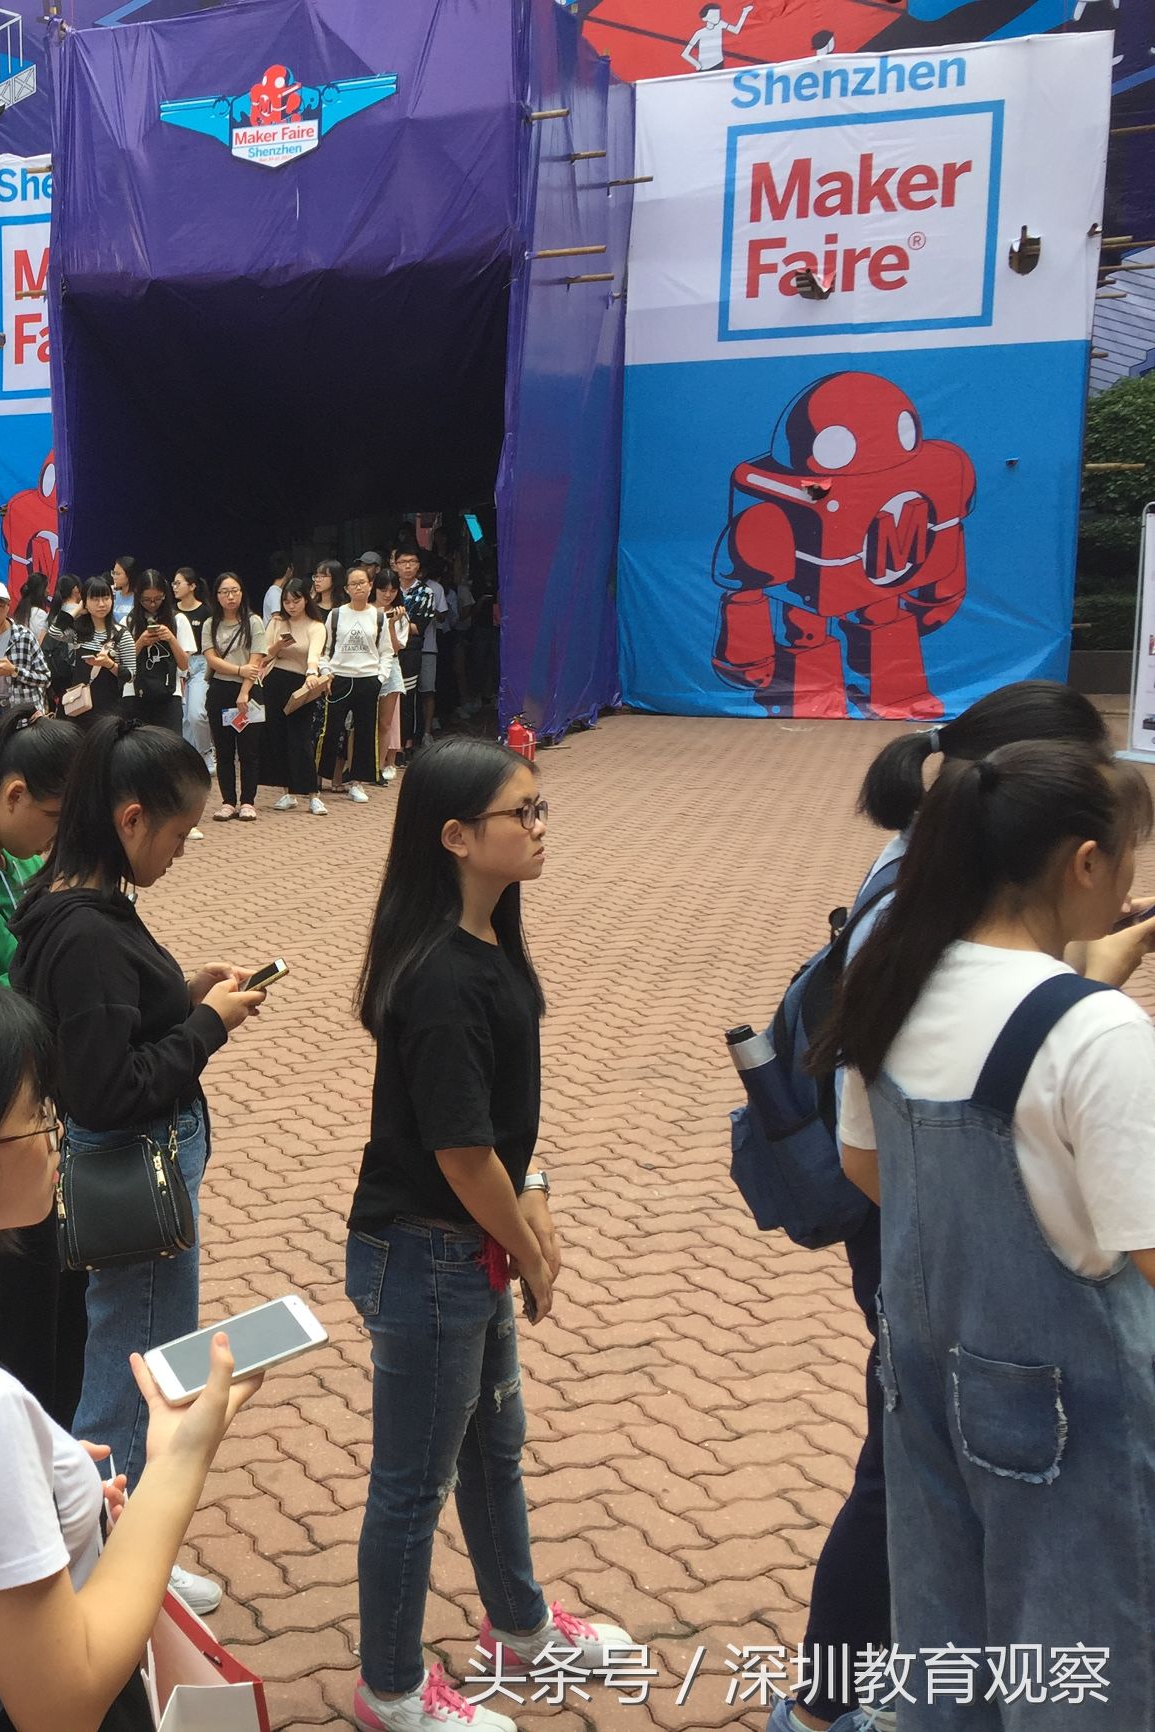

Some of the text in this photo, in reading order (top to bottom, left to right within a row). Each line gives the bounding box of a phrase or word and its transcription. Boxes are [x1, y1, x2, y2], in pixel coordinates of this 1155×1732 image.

[731, 55, 967, 109] Shenzhen
[234, 125, 315, 146] Maker Faire
[248, 144, 302, 158] Shenzhen
[749, 153, 973, 223] Maker
